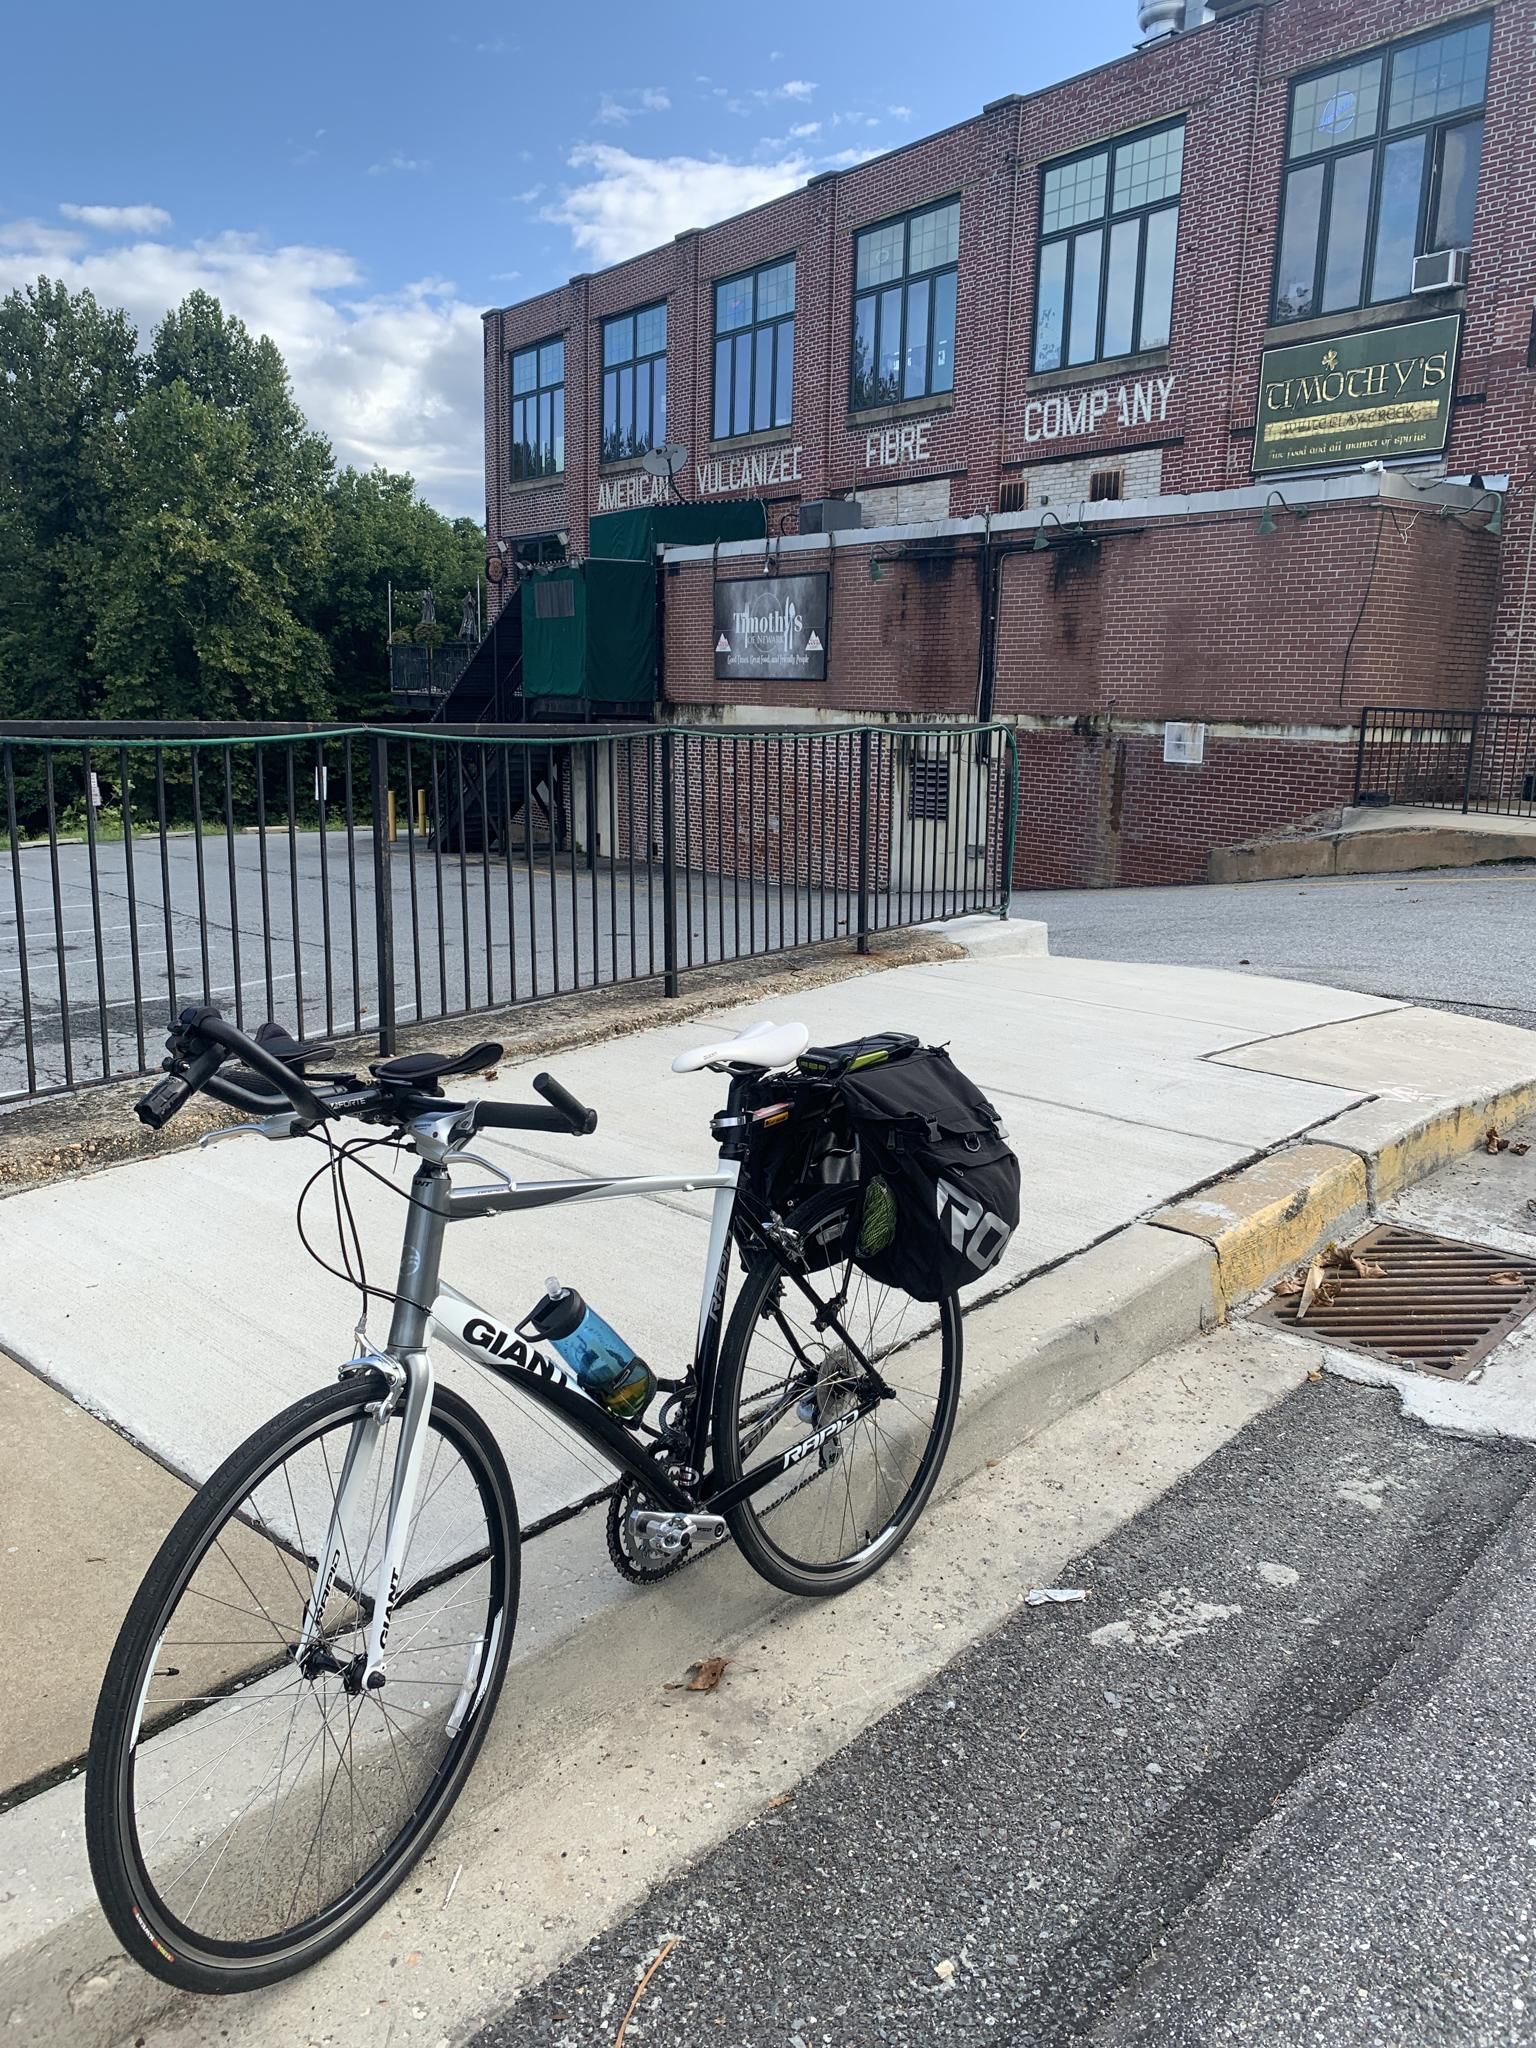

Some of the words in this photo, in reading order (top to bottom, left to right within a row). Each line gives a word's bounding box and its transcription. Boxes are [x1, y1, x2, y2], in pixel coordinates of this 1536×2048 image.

[1266, 350, 1448, 414] TIMOTHY'S
[597, 474, 670, 510] AMERICAN
[866, 422, 931, 467] FIBRE
[1024, 376, 1176, 442] COMPANY
[936, 1177, 1013, 1271] RO
[783, 1409, 860, 1470] RAPID
[379, 1567, 399, 1650] GIANT
